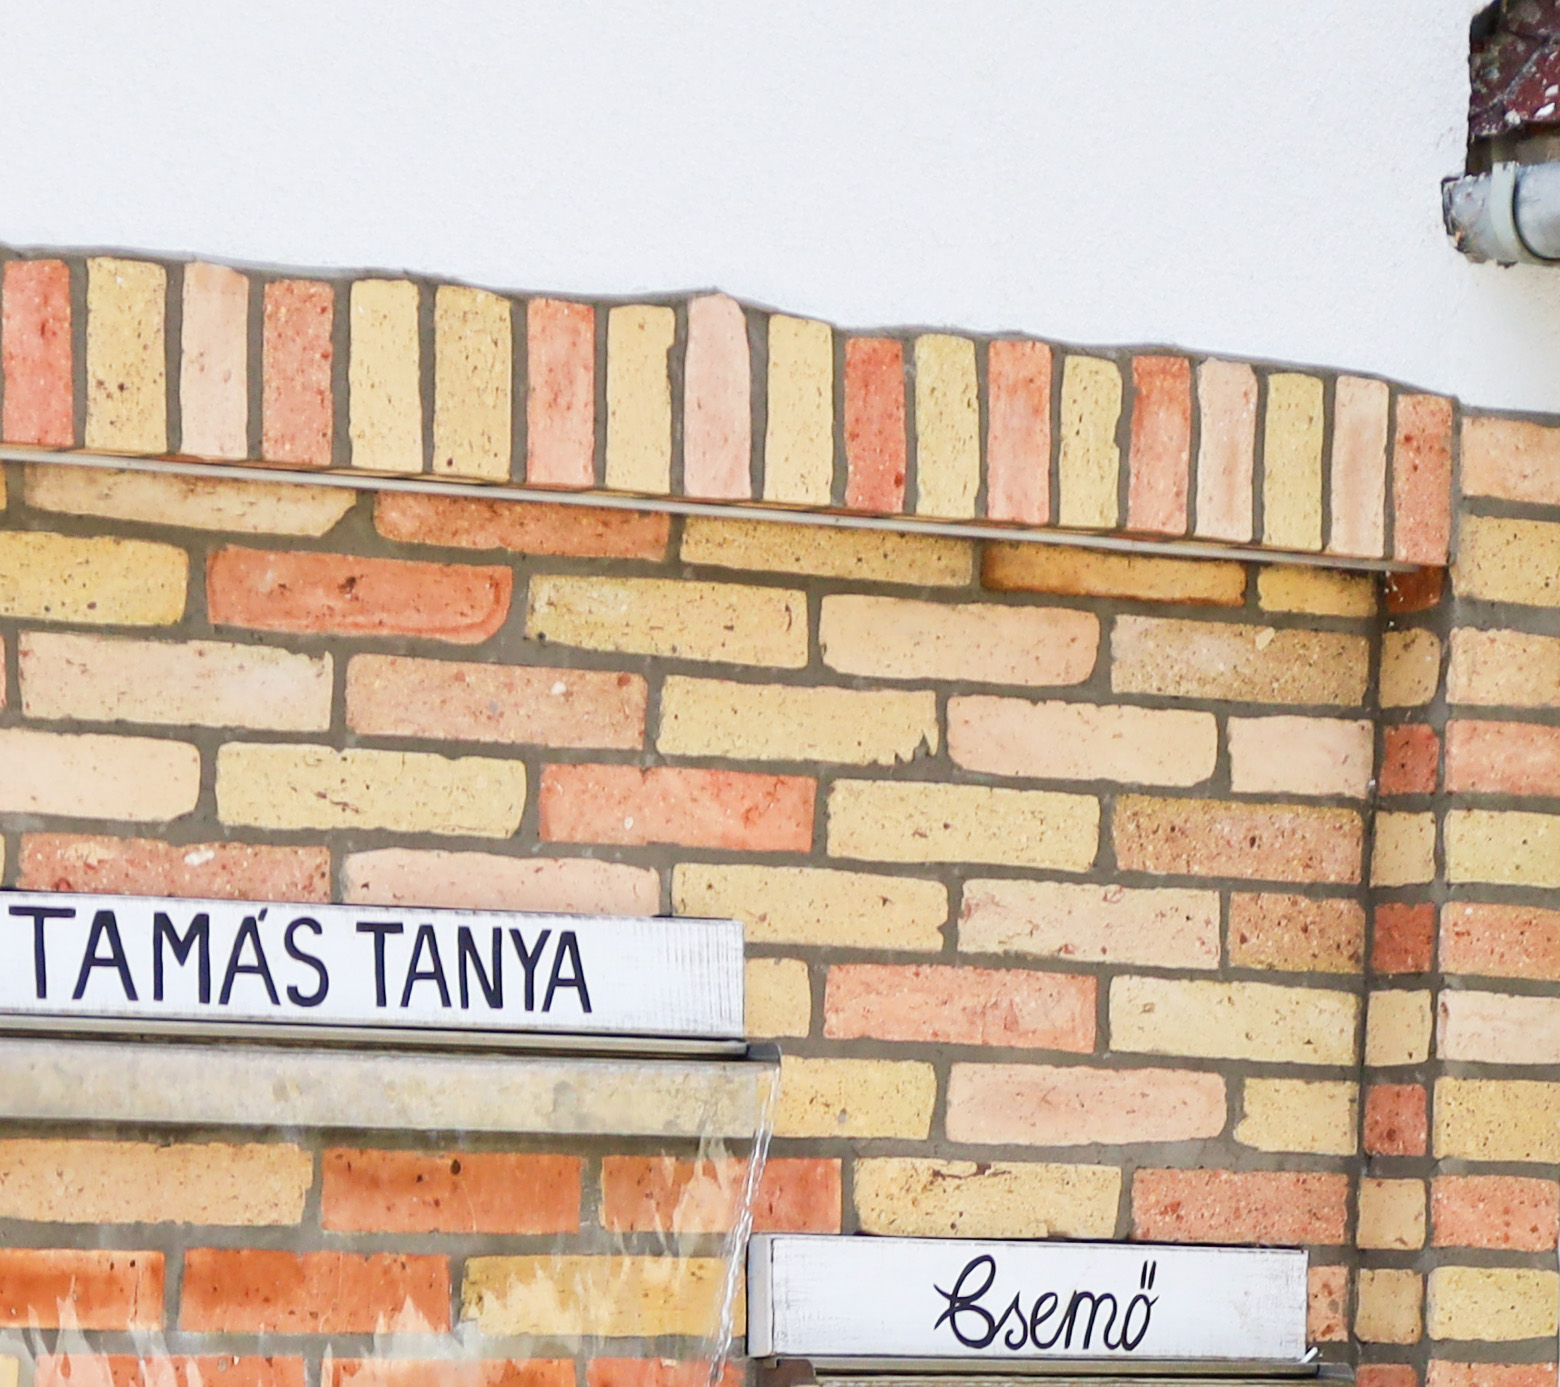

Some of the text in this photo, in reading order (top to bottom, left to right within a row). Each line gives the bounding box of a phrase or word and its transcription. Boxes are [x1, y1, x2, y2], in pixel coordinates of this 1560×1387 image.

[7, 905, 593, 1014] TAMÁS TANYA
[933, 1253, 1160, 1352] Csemő
